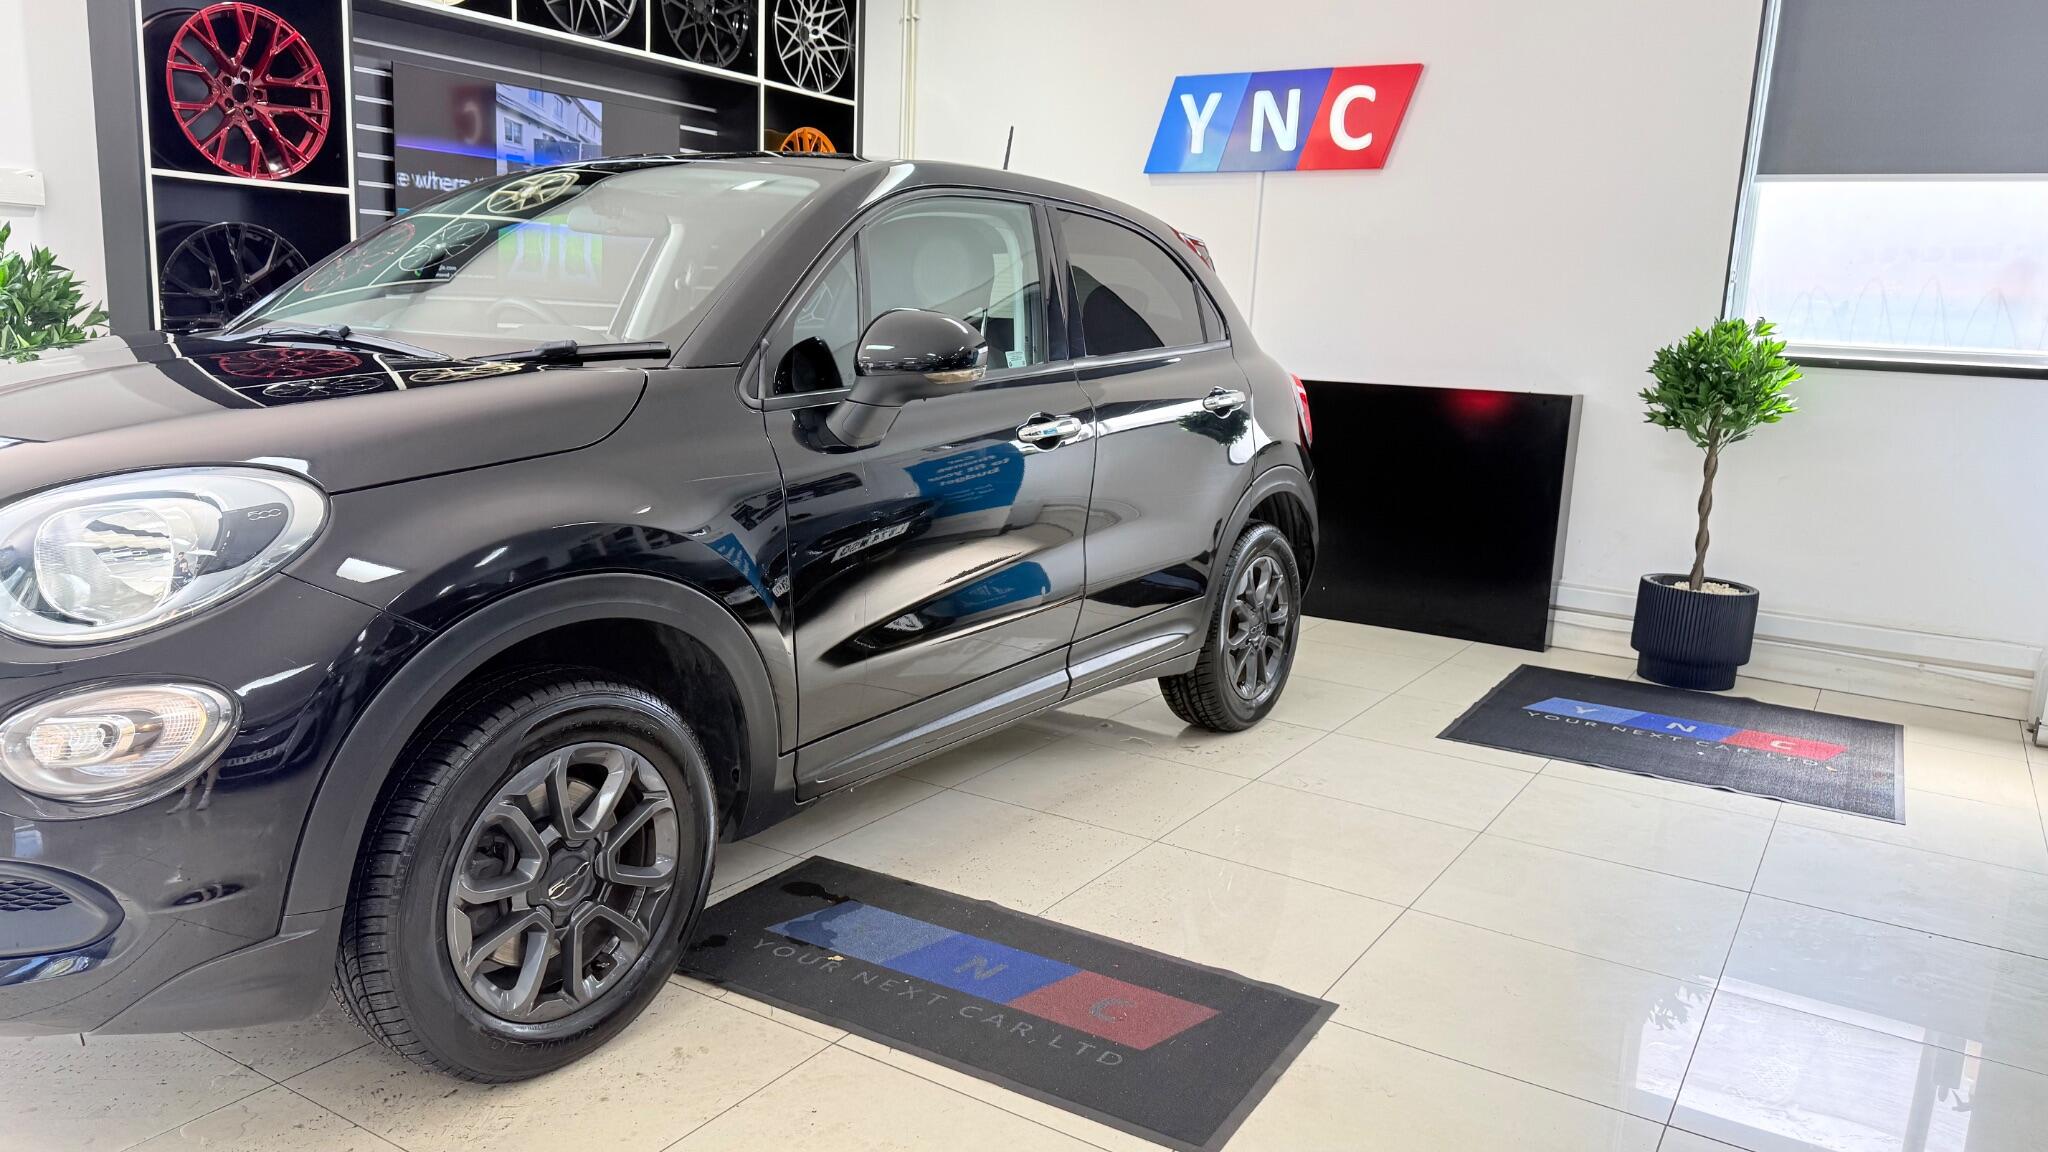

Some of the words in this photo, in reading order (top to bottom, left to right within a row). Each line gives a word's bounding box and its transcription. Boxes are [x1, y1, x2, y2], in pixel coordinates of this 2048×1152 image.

[1180, 84, 1377, 154] YNC
[1527, 711, 1599, 728] YOUR
[1611, 726, 1682, 742] NEXT
[753, 938, 842, 974] YOUR
[851, 970, 949, 1006] NEXT
[1048, 1034, 1123, 1066] LTD
